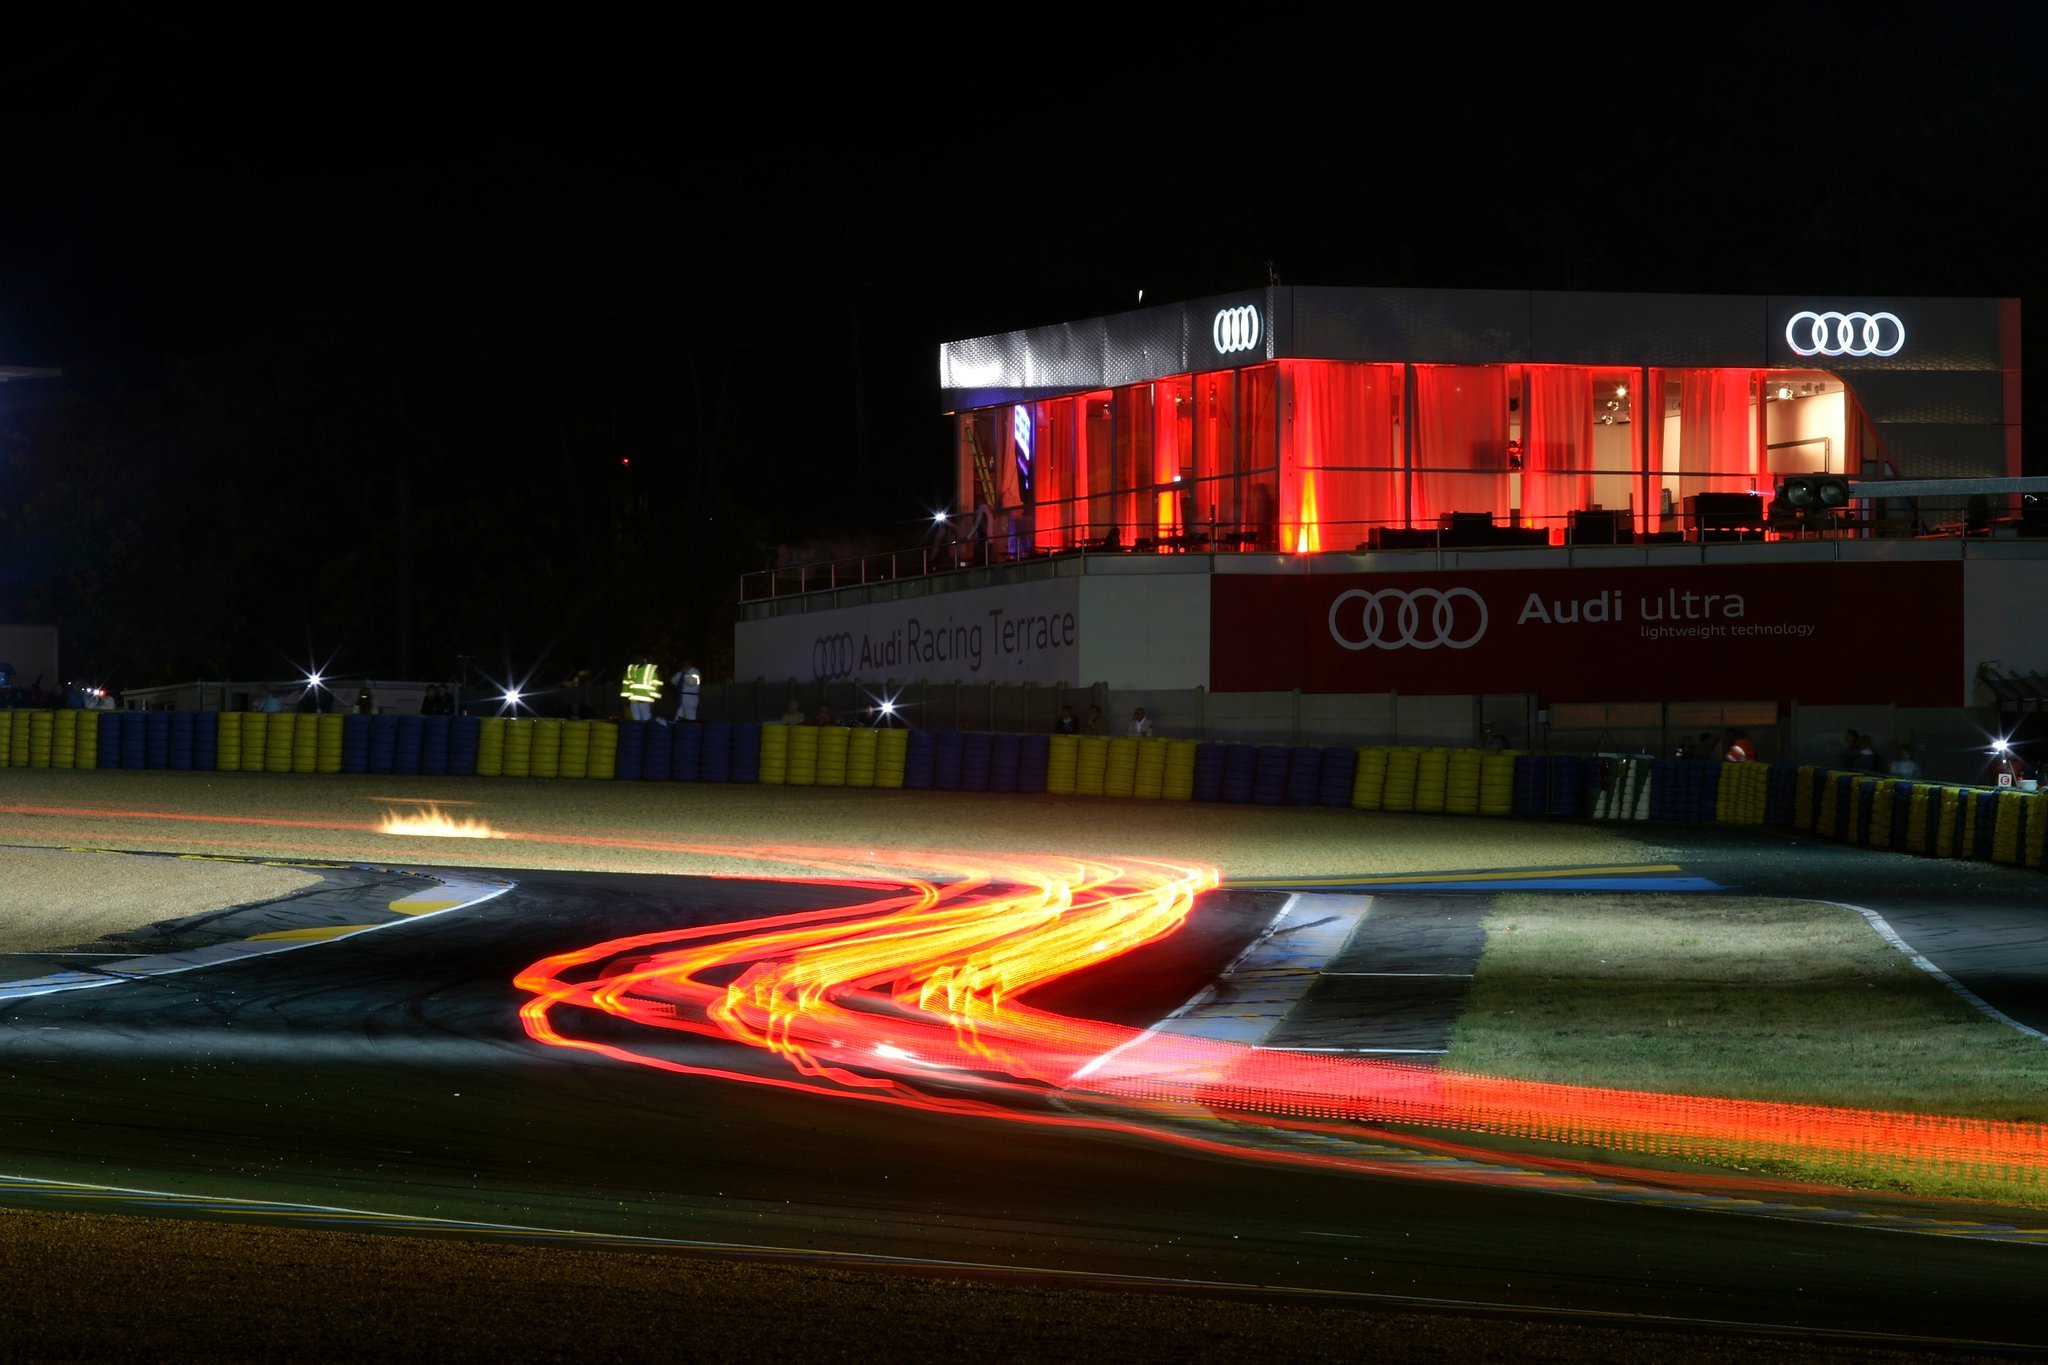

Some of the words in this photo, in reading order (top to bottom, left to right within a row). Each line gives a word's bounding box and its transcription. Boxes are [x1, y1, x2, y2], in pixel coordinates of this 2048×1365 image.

[1517, 590, 1623, 625] Audi
[1640, 588, 1745, 620] ultra
[859, 629, 902, 671] Audi
[907, 616, 982, 671] Racing
[989, 608, 1075, 654] Terrace
[1640, 625, 1727, 640] lightweight
[1731, 622, 1816, 637] technology
